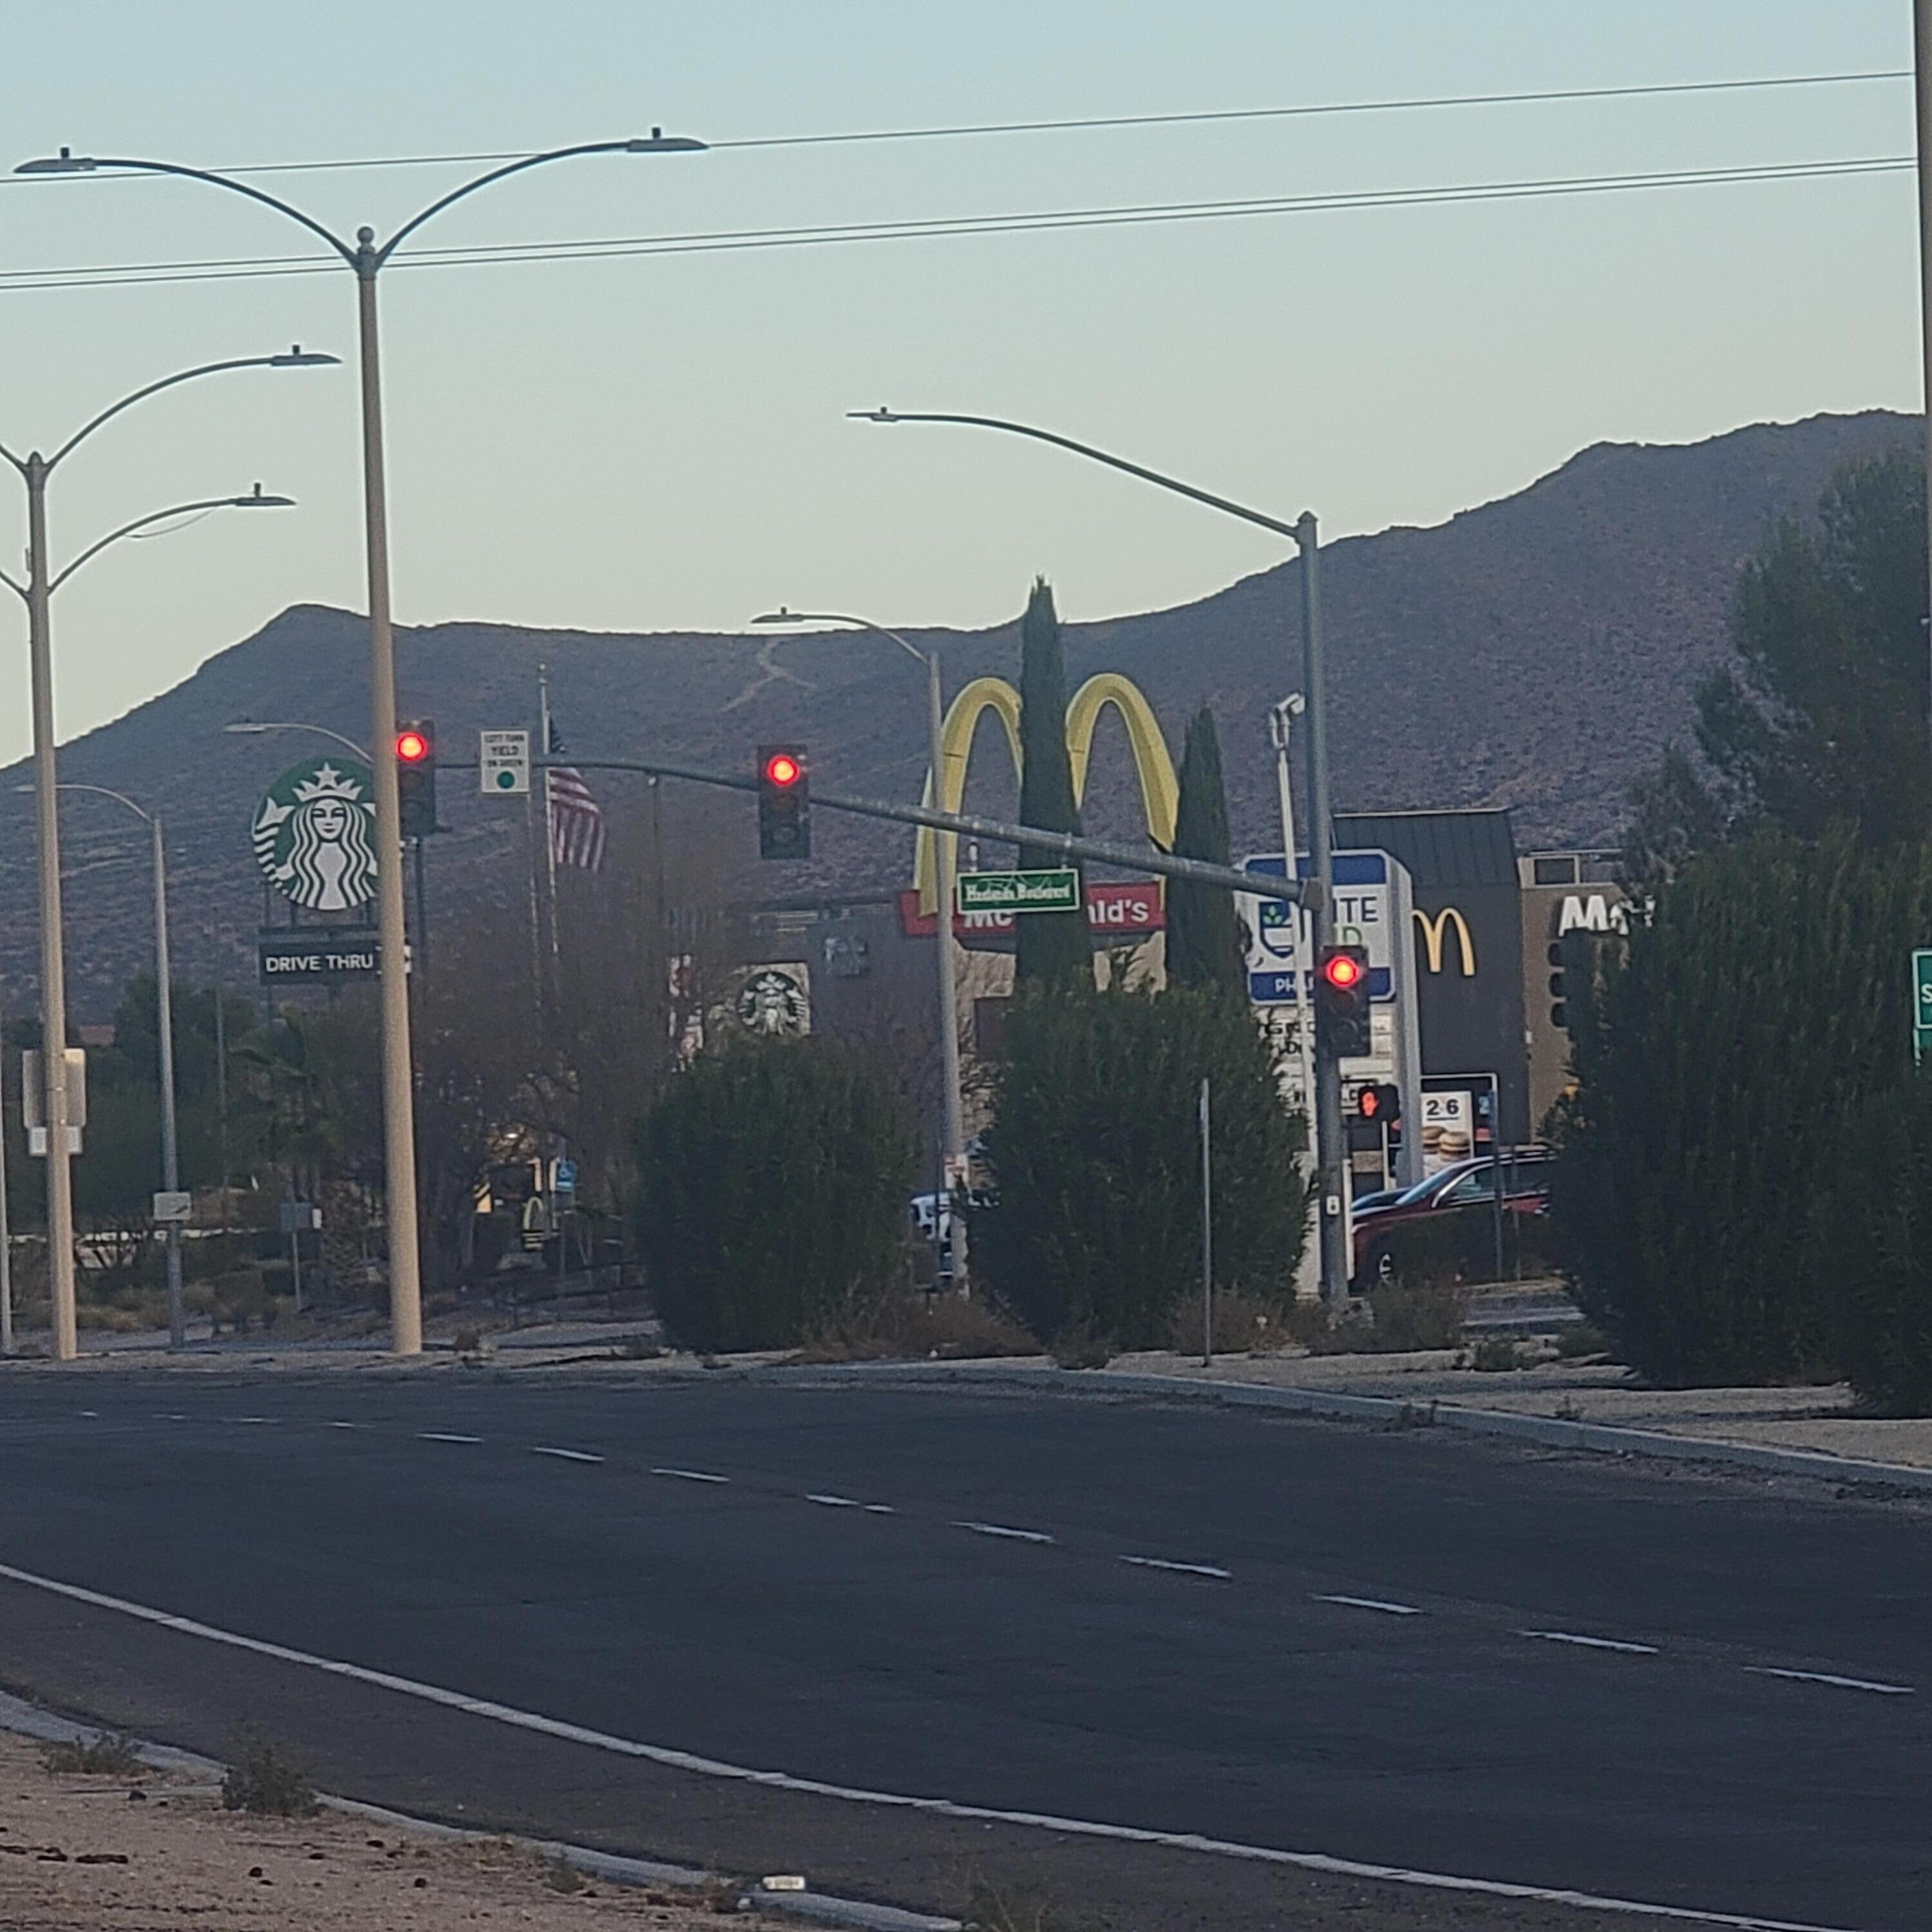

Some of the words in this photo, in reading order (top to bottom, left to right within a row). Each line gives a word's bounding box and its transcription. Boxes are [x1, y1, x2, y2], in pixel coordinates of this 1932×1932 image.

[1332, 896, 1379, 923] ITE
[265, 956, 321, 972] DRIVE
[325, 953, 374, 970] THRU
